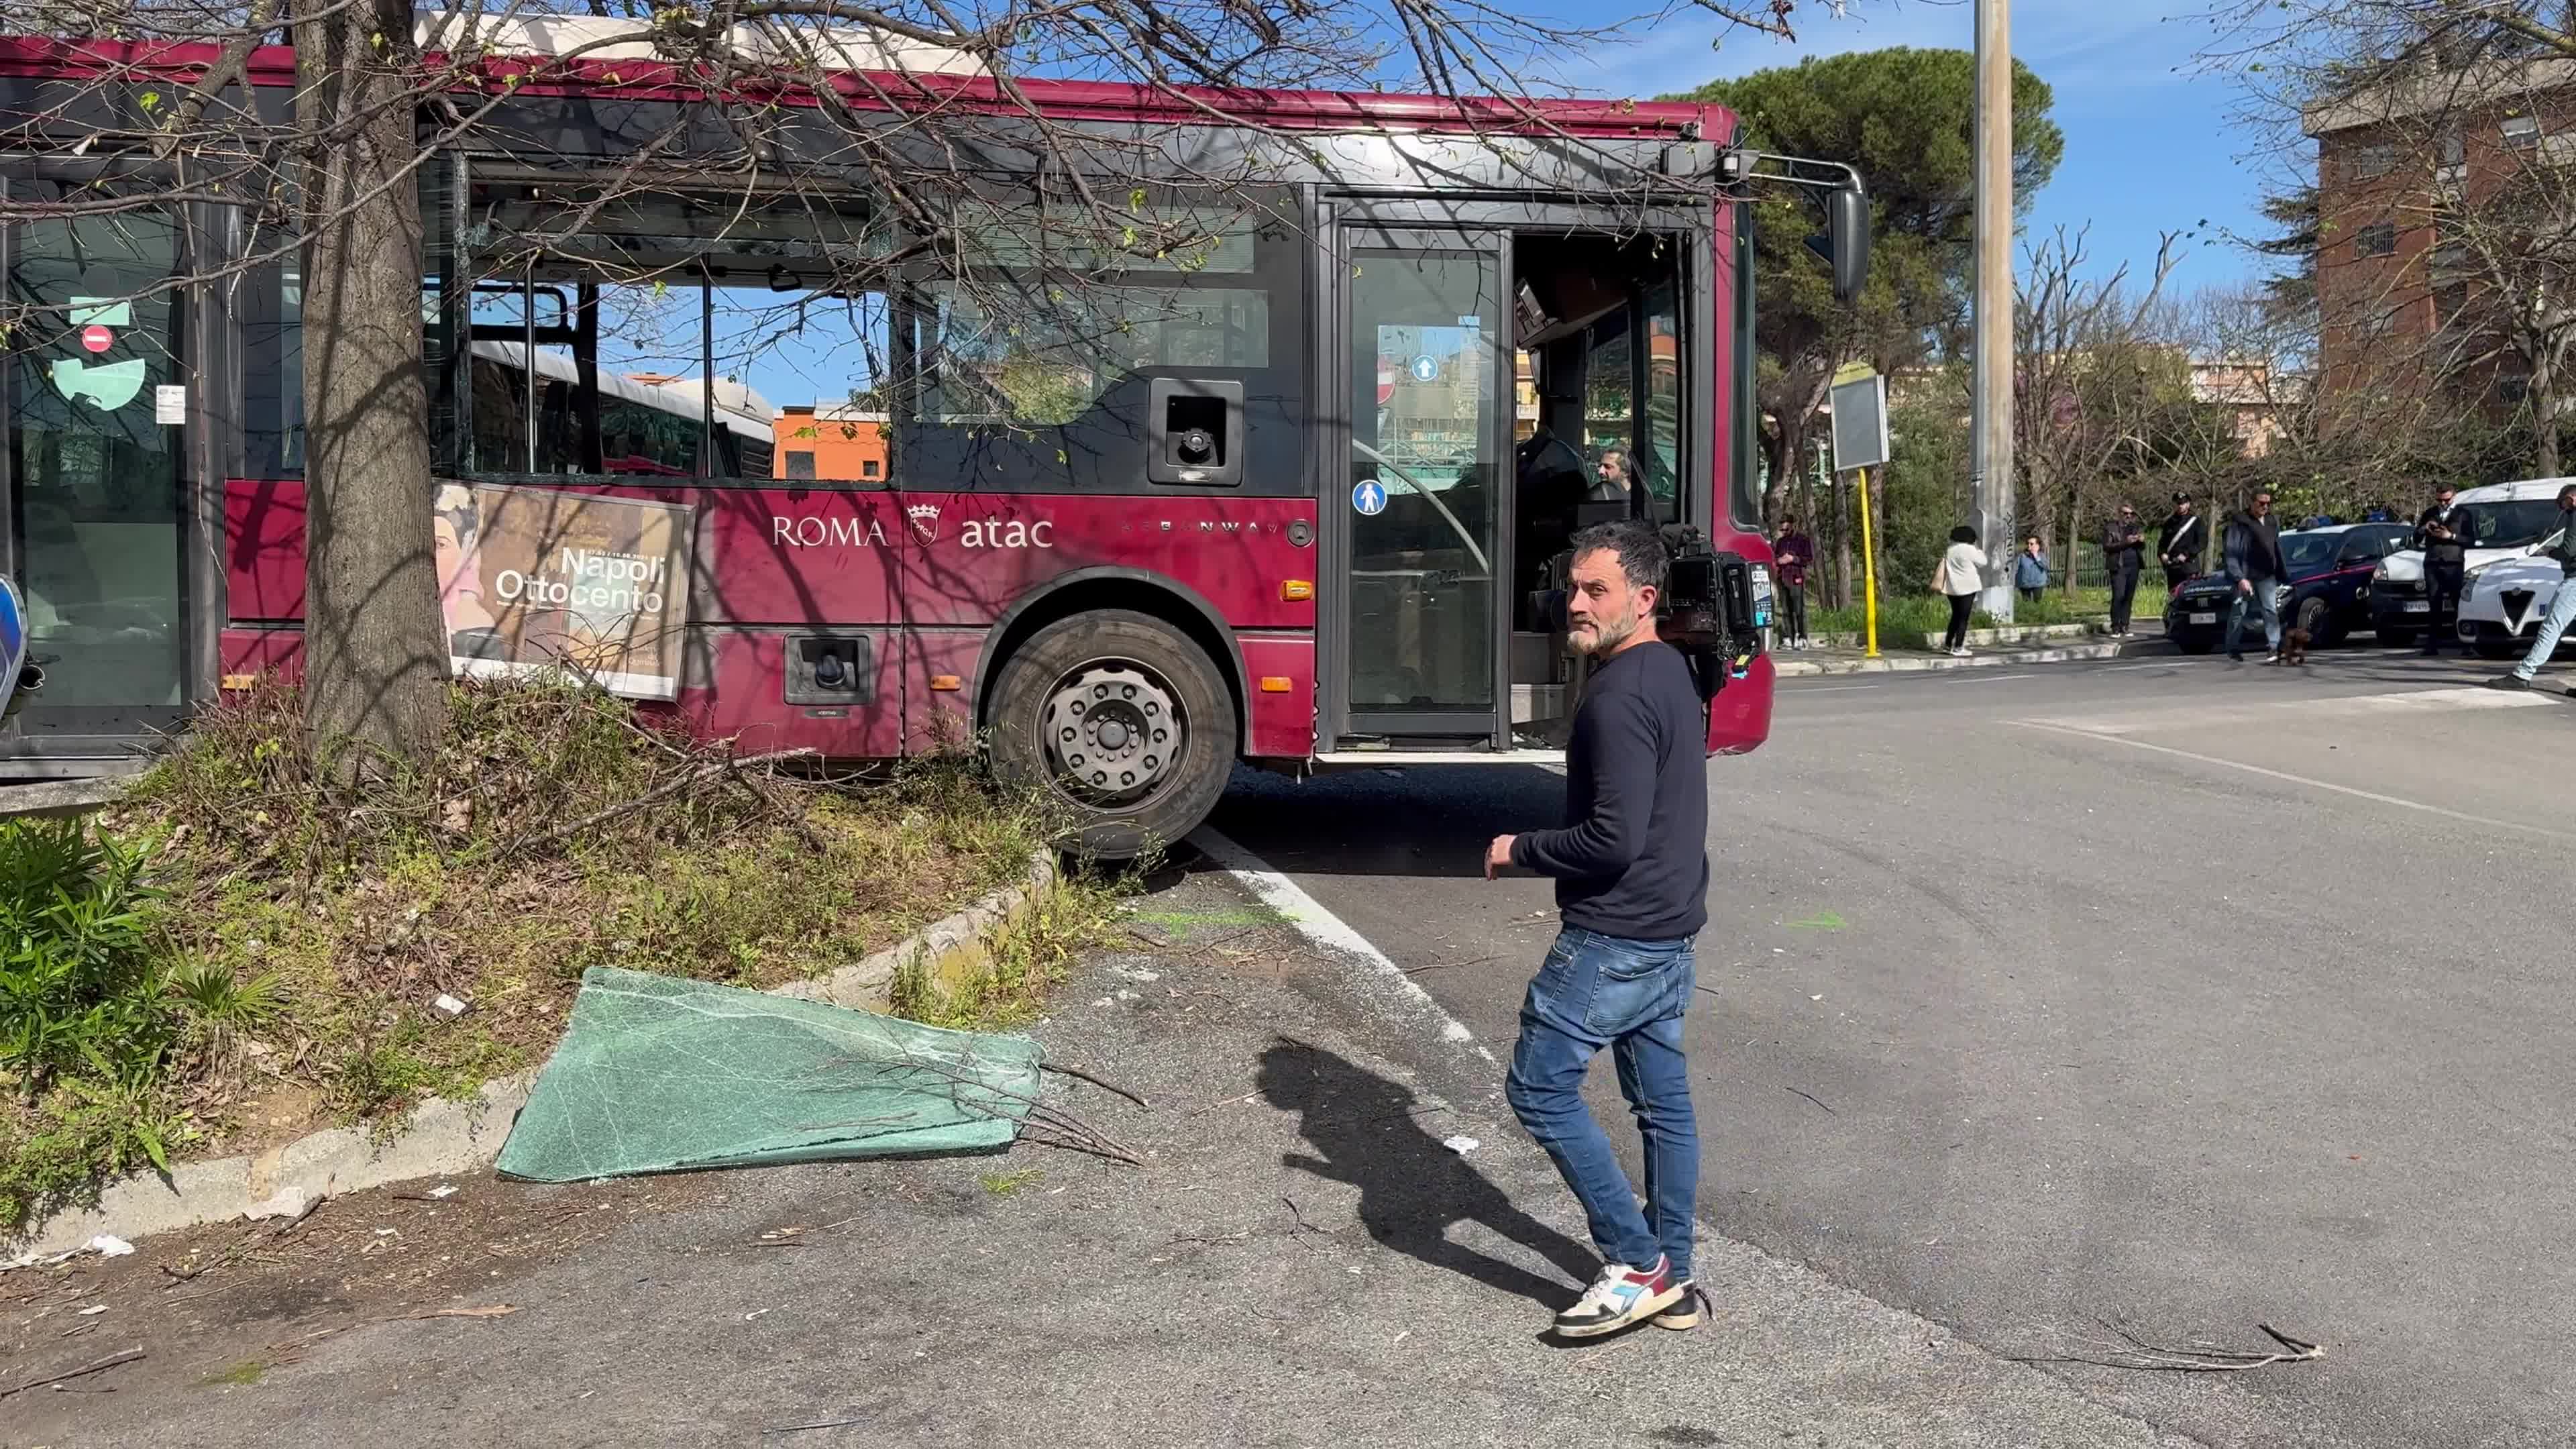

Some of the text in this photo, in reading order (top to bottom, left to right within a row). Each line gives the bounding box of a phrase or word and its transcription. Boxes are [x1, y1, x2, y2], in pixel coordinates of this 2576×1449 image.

[772, 516, 890, 547] ROMA
[961, 515, 1053, 548] atac
[561, 547, 665, 584] Napoli
[496, 569, 663, 613] Ottocento
